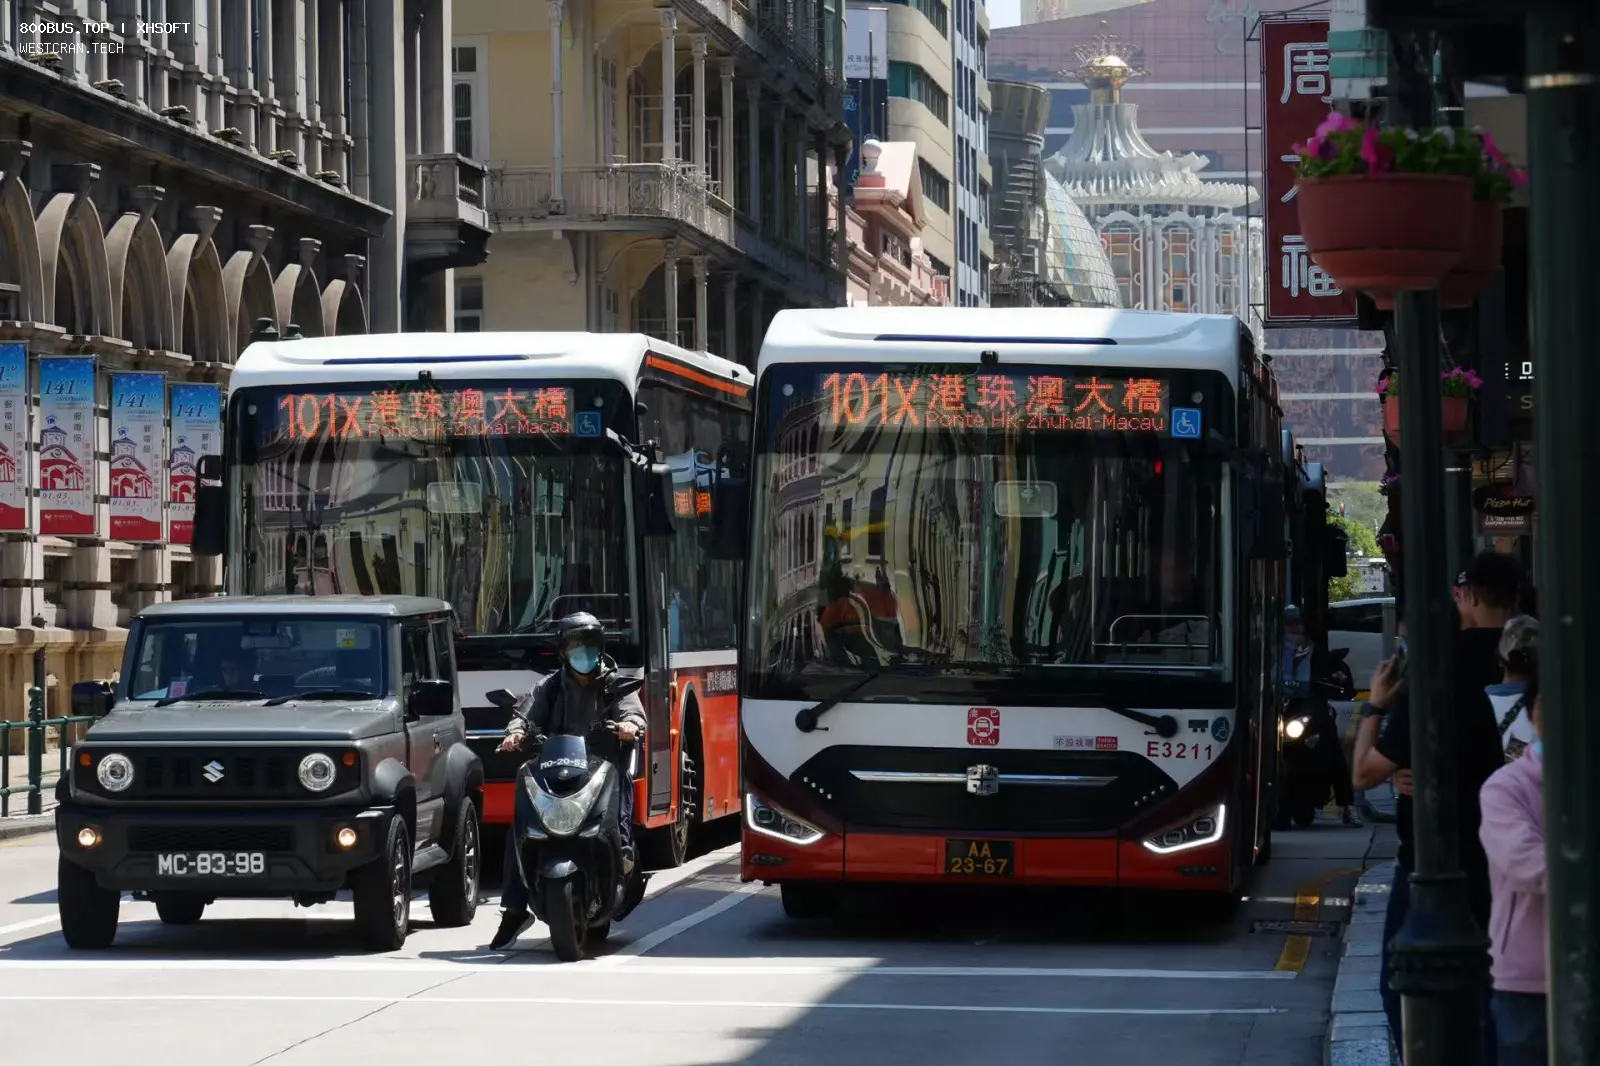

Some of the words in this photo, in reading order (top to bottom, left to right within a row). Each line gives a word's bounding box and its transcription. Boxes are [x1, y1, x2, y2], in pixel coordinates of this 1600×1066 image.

[1280, 42, 1343, 297] 周福
[369, 388, 567, 421] 港珠澳大橋
[822, 372, 920, 425] 101X
[928, 375, 1164, 414] 港珠澳大橋
[279, 393, 362, 438] 101X
[926, 412, 984, 429] Ponte
[368, 423, 418, 437] Ponte
[1147, 740, 1213, 761] E3211
[968, 841, 991, 857] AA
[158, 852, 265, 876] MC-83-98
[951, 857, 1008, 874] 23-67
